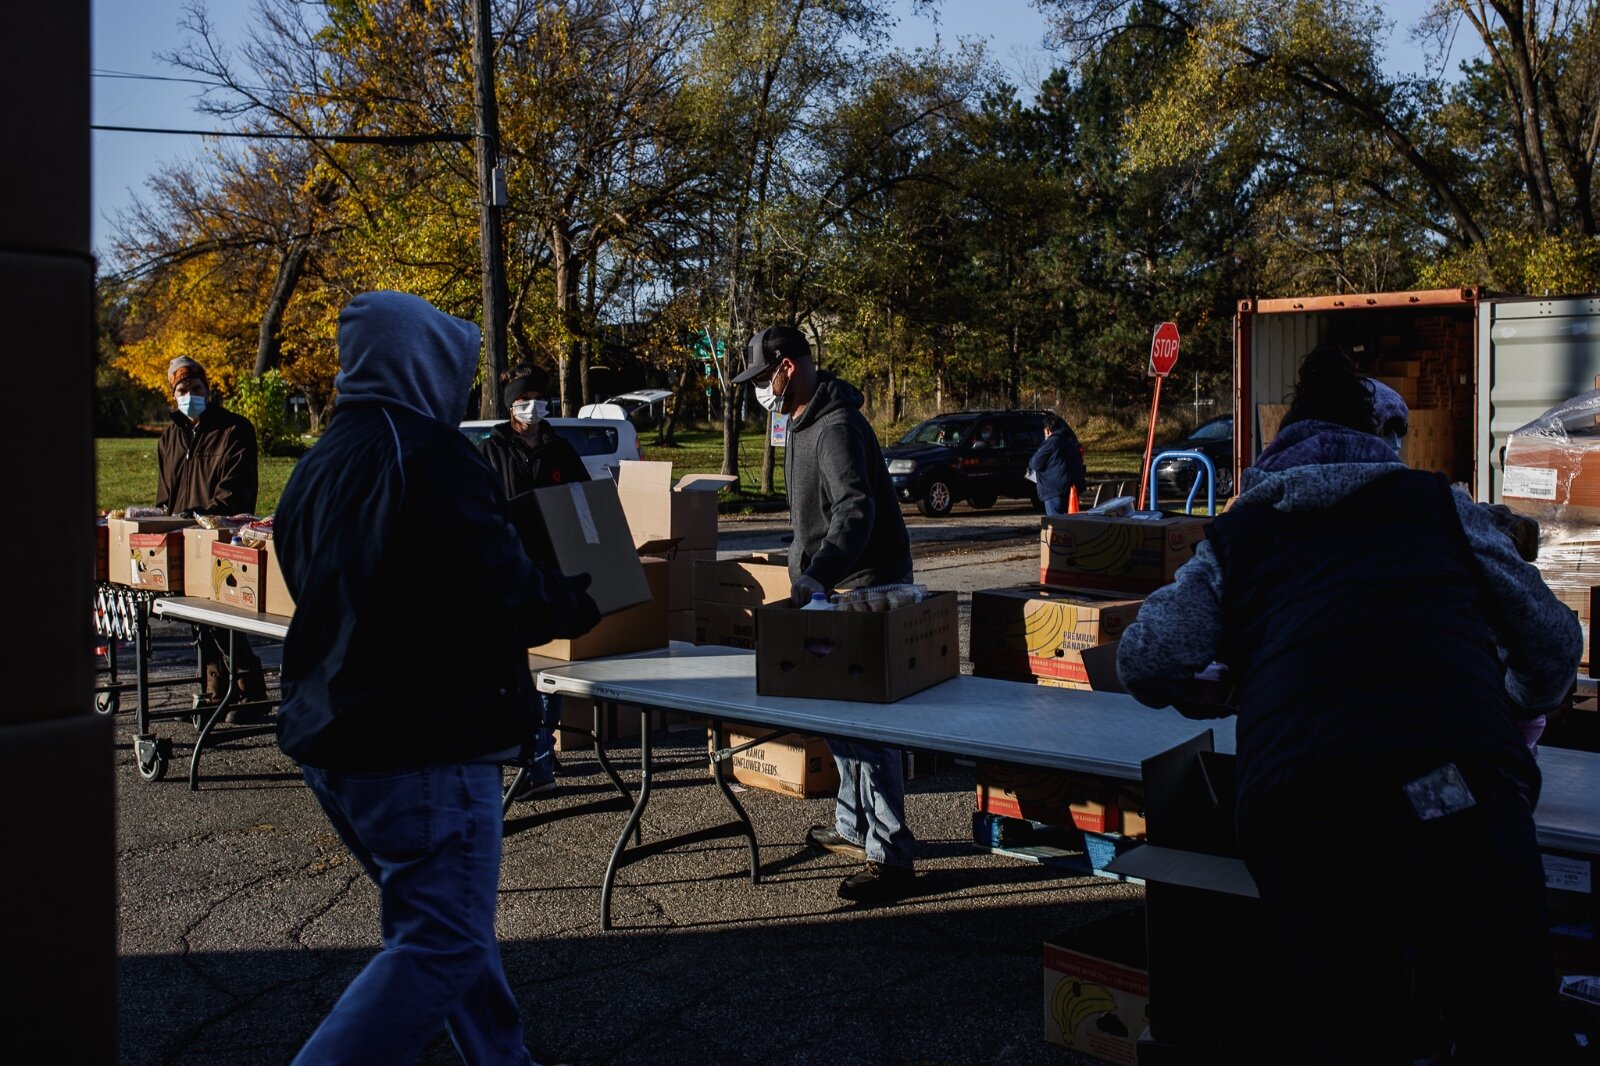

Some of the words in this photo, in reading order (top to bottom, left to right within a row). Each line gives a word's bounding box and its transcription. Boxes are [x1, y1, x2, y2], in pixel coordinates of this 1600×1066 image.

[1154, 339, 1178, 358] STOP
[1063, 631, 1096, 643] PREMIUM
[745, 748, 766, 761] RANCH
[732, 756, 761, 773] UNFLOWER
[761, 762, 778, 776] SEEDS
